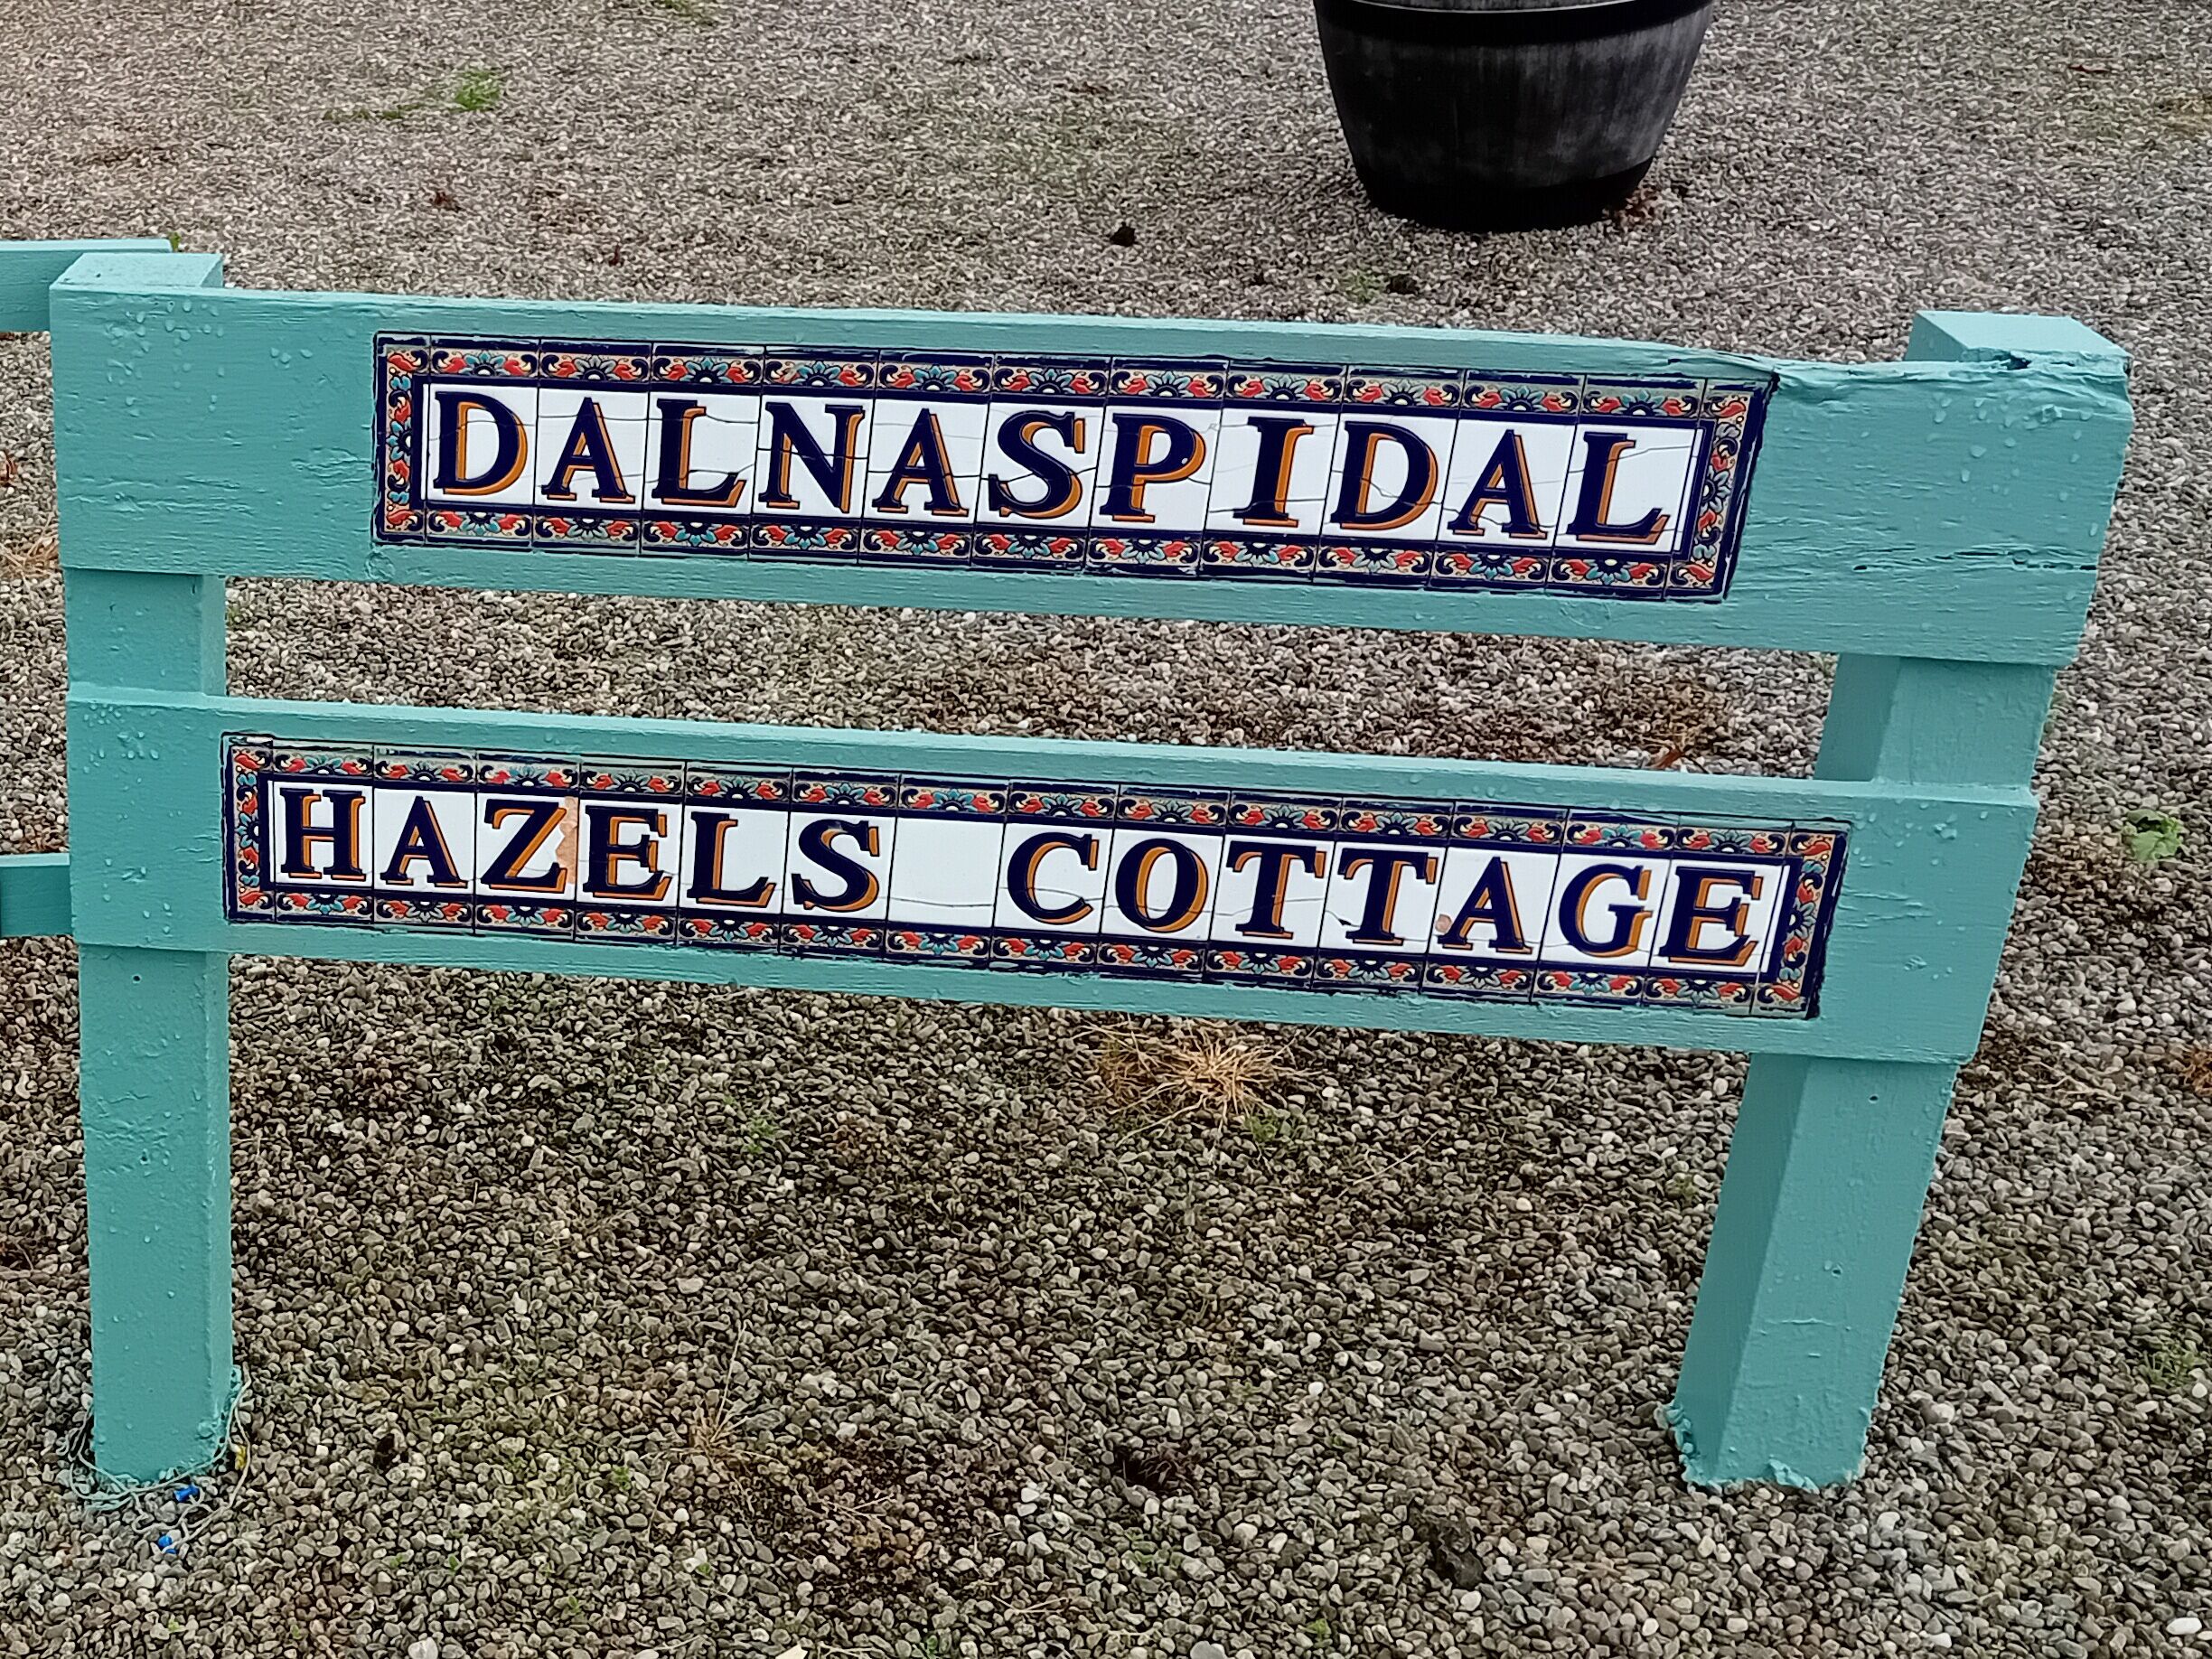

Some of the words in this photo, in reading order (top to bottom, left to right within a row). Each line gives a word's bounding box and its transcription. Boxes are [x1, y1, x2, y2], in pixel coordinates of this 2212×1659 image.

[433, 392, 1669, 543] DALNASPIDAL
[280, 788, 880, 913] HAZELS
[1008, 830, 1764, 964] COTTAGE
